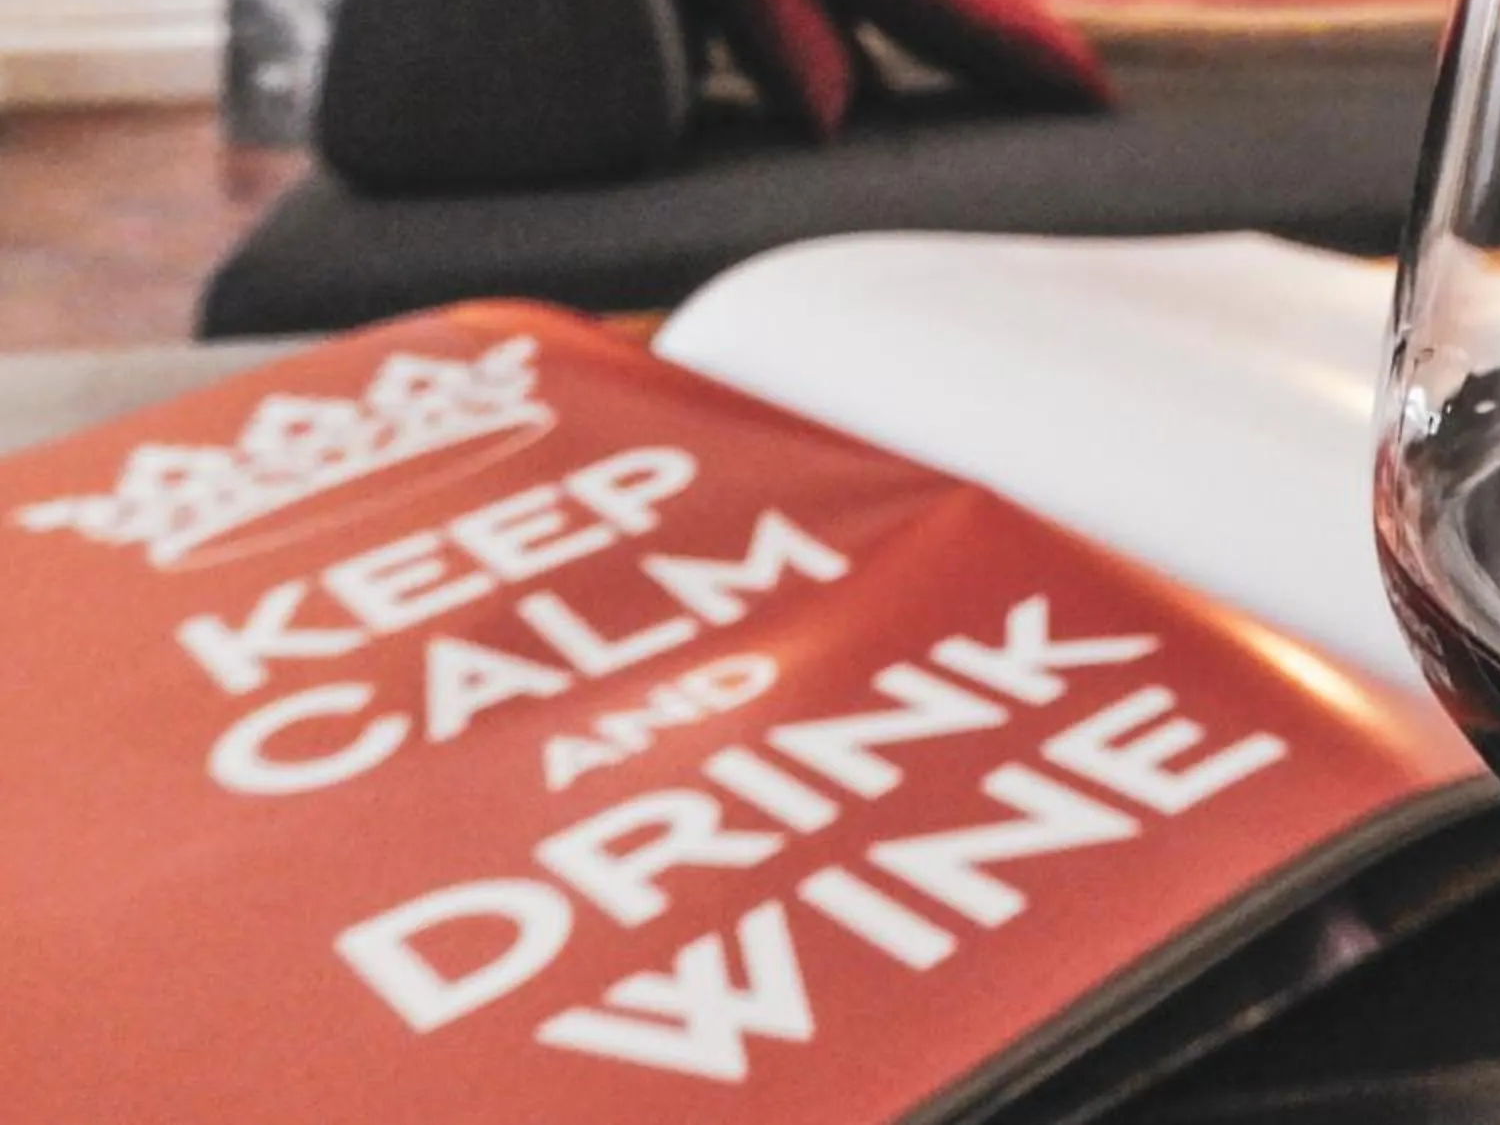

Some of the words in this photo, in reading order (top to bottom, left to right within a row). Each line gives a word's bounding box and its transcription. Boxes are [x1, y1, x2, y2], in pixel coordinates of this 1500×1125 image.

[176, 448, 700, 695] KEEP
[207, 508, 850, 797] CALM
[334, 594, 1161, 1034] DRINK
[541, 653, 780, 791] AND
[535, 685, 1288, 1083] WINE
